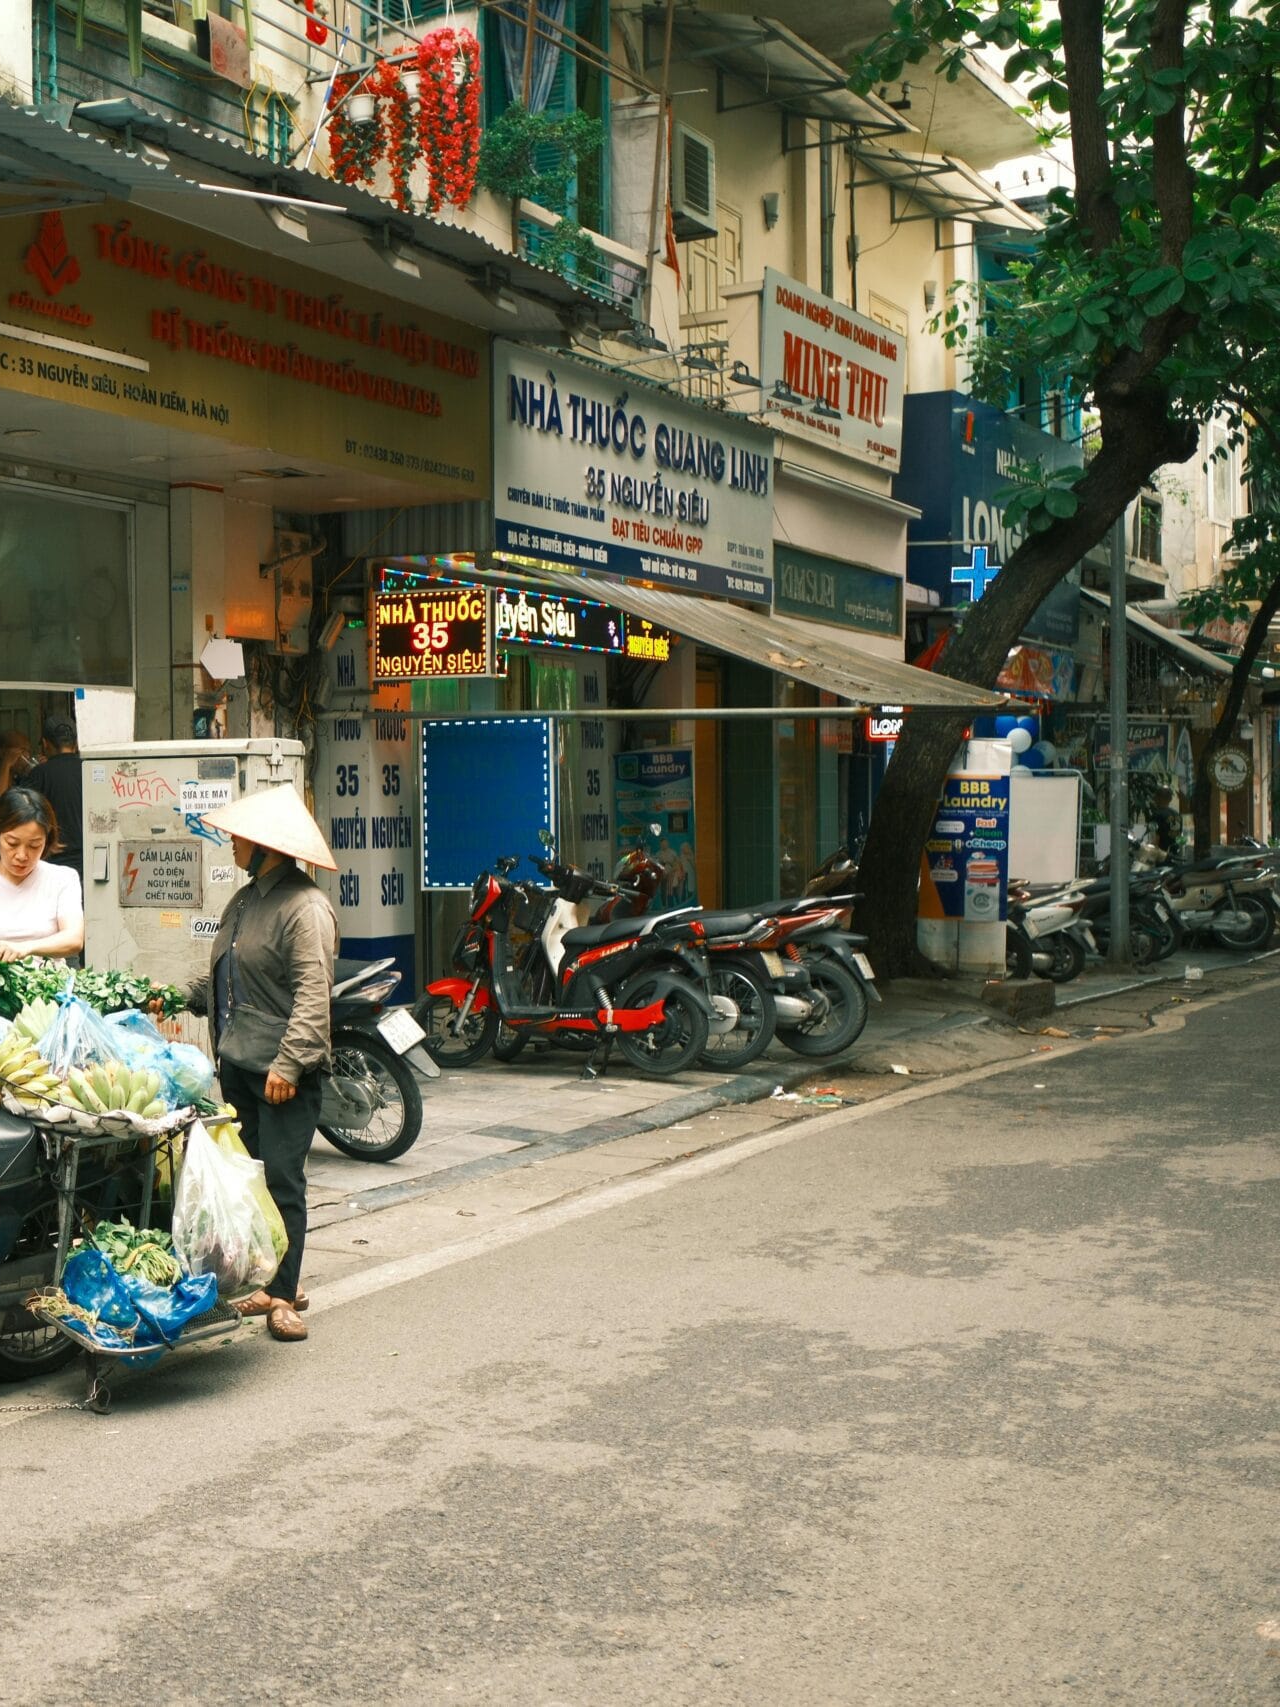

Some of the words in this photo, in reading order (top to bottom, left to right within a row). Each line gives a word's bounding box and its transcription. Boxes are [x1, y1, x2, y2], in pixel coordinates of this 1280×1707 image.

[93, 219, 174, 278] TỔNG
[176, 249, 247, 304] CÔNG
[248, 277, 277, 315] TY
[282, 288, 356, 342] THUỐC
[389, 322, 431, 368] VIỆT
[434, 338, 480, 380] NAM
[150, 306, 184, 352] HỆ
[187, 319, 258, 368] THỐNG
[776, 284, 804, 316] DOANH
[805, 300, 834, 332] NGHIỆP
[834, 314, 852, 340] KINH
[853, 324, 878, 353] DOANH
[879, 335, 897, 361] VÀNG
[19, 357, 34, 376] 33
[37, 362, 89, 391] NGUYỄN
[91, 373, 120, 399] SIÊU,
[123, 383, 157, 407] HOÀN
[160, 388, 191, 415] KIẾM,
[192, 398, 208, 420] HÀ
[210, 405, 230, 427] NỘI
[784, 330, 842, 412] MINH
[847, 360, 888, 428] THU
[508, 370, 563, 436] NHÀ
[568, 390, 646, 460] THUỐC
[652, 422, 725, 482] QUANG
[727, 444, 769, 497] LINH
[507, 486, 531, 505] CHUYÊN
[531, 490, 543, 508] BÁN
[552, 495, 570, 514] THUỐC
[571, 501, 589, 518] THÀNH
[589, 503, 605, 522] PHẨM
[585, 465, 606, 501] 35
[608, 471, 675, 519] NGUYỄN
[677, 487, 709, 527] SIÊU
[531, 535, 539, 549] 35
[612, 517, 630, 542] ĐẠT
[632, 521, 649, 544] TIÊU
[652, 523, 683, 551] CHUẨN
[685, 538, 703, 555] GPP
[379, 598, 416, 626] NHÀ
[421, 591, 482, 621] THUỐC
[413, 602, 449, 650] 35
[541, 601, 576, 637] Siêu
[337, 648, 356, 688] NHÀ
[381, 647, 443, 679] NGUYỄN
[447, 645, 481, 674] SIÊU
[642, 764, 686, 775] Laundry
[652, 753, 674, 765] BBB
[200, 790, 209, 799] XE
[336, 764, 360, 797] 35
[382, 764, 401, 797] 35
[587, 769, 601, 796] 35
[959, 781, 990, 794] BBB
[943, 795, 1008, 811] Laundry
[331, 807, 367, 850] NGUYỄN
[372, 805, 412, 849] NGUYỄN
[975, 818, 997, 828] Fast
[139, 848, 158, 862] CẤM
[160, 851, 173, 865] LẠI
[153, 866, 165, 876] CÓ
[166, 866, 185, 878] ĐIỆN
[145, 890, 165, 900] CHẾT
[168, 890, 192, 901] NGƯỜI
[148, 880, 169, 888] NGUY
[340, 868, 360, 907] SIÊU
[381, 866, 404, 907] SIÊU
